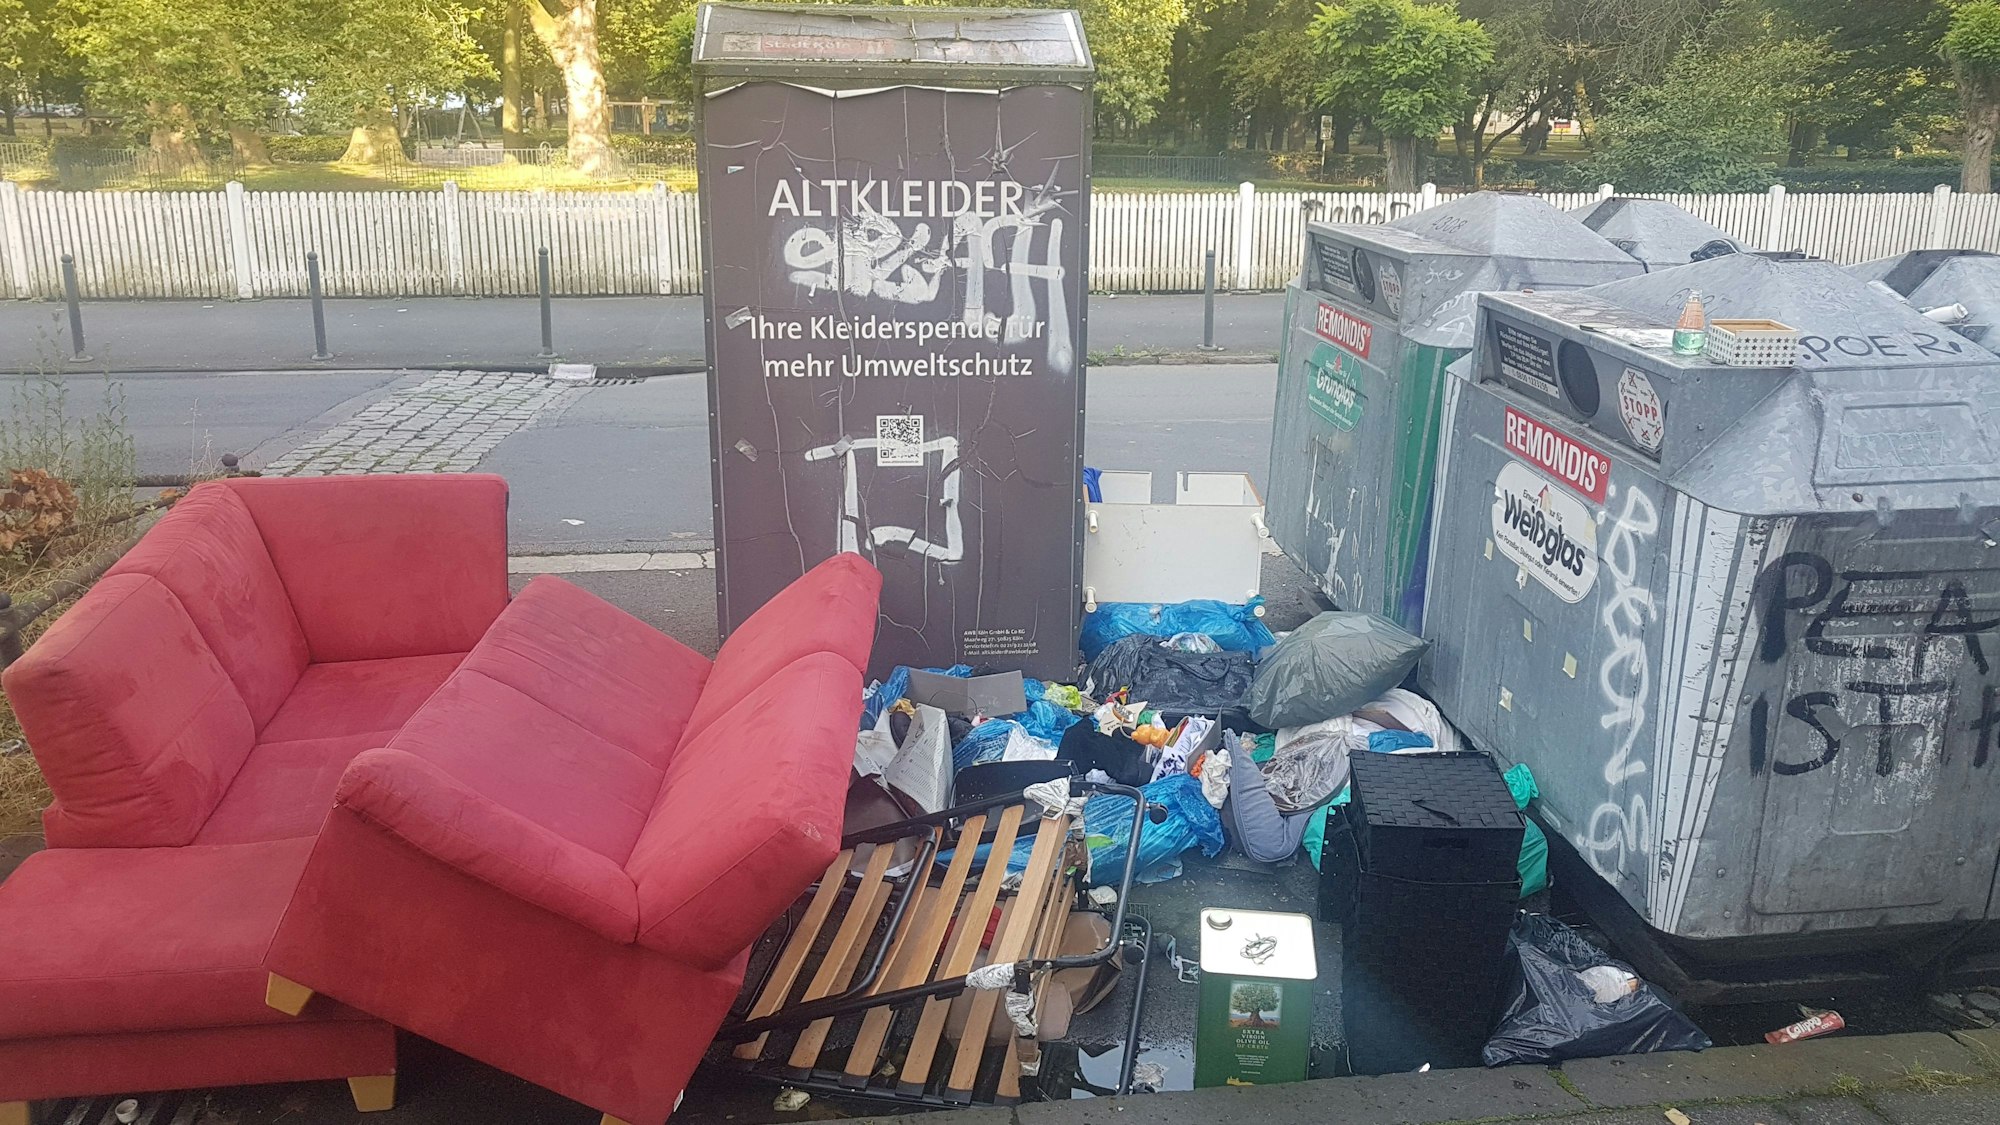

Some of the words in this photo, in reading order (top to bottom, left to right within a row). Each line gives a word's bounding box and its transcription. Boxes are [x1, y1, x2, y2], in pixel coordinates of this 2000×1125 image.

[768, 179, 1023, 217] ALTKLEIDER
[750, 315, 802, 340] Ihre
[811, 315, 1001, 347] Kleiderspende
[1007, 315, 1045, 340] für
[764, 352, 834, 377] mehr
[842, 353, 1032, 377] Umweltschutz
[1624, 395, 1657, 421] STOPP
[1504, 489, 1586, 577] Weißglas
[1786, 1016, 1822, 1039] Calippo
[1822, 1021, 1834, 1030] COLA
